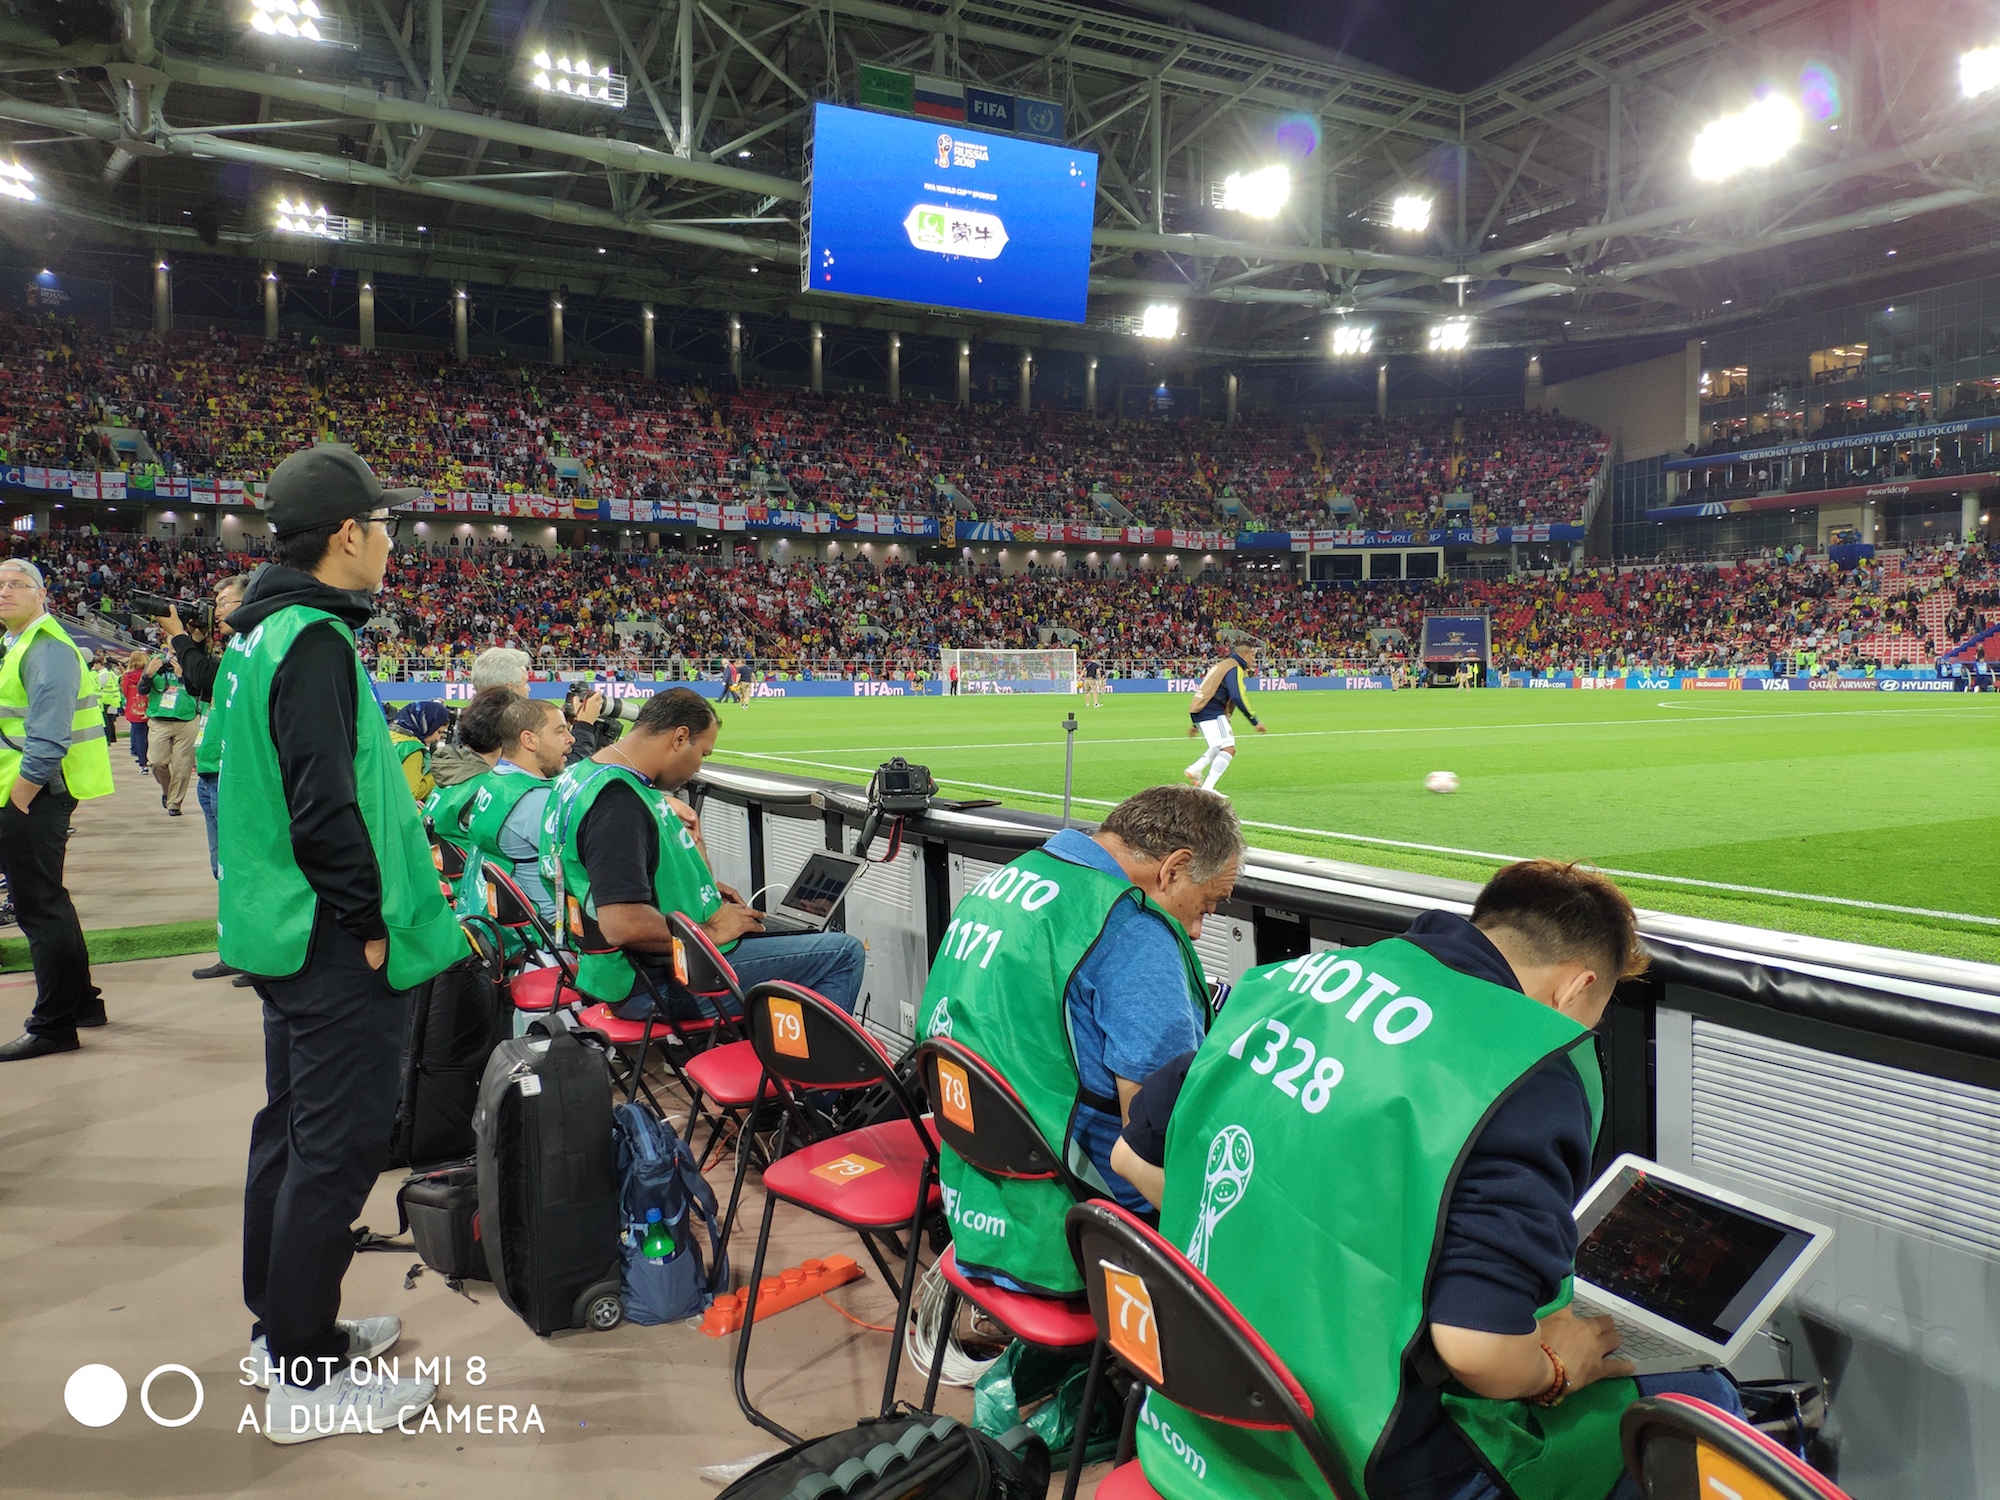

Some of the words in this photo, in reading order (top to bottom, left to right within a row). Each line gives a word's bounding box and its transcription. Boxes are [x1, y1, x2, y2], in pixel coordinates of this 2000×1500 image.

[974, 100, 1007, 119] FIFA
[953, 156, 976, 168] 2018
[954, 147, 989, 161] RUSSIA
[1740, 447, 1789, 461] ЧЕМПИОНАТ
[1791, 444, 1816, 455] МИРА
[1817, 442, 1830, 451] ПО
[1831, 436, 1873, 449] ФУТБОЛУ
[1875, 434, 1894, 444] FIFA
[1895, 430, 1917, 440] 2018
[1927, 423, 1968, 436] РОССИИ
[1866, 486, 1910, 496] #worldcup
[1760, 679, 1790, 690] VISA
[1901, 680, 1954, 691] HYUNDAI
[970, 866, 1061, 911] HOTO
[944, 918, 1003, 969] 1171
[1262, 952, 1434, 1045] PHOTO
[774, 1012, 801, 1041] 79
[941, 1071, 967, 1110] 78
[827, 1158, 866, 1176] 79
[1114, 1284, 1150, 1344] 77
